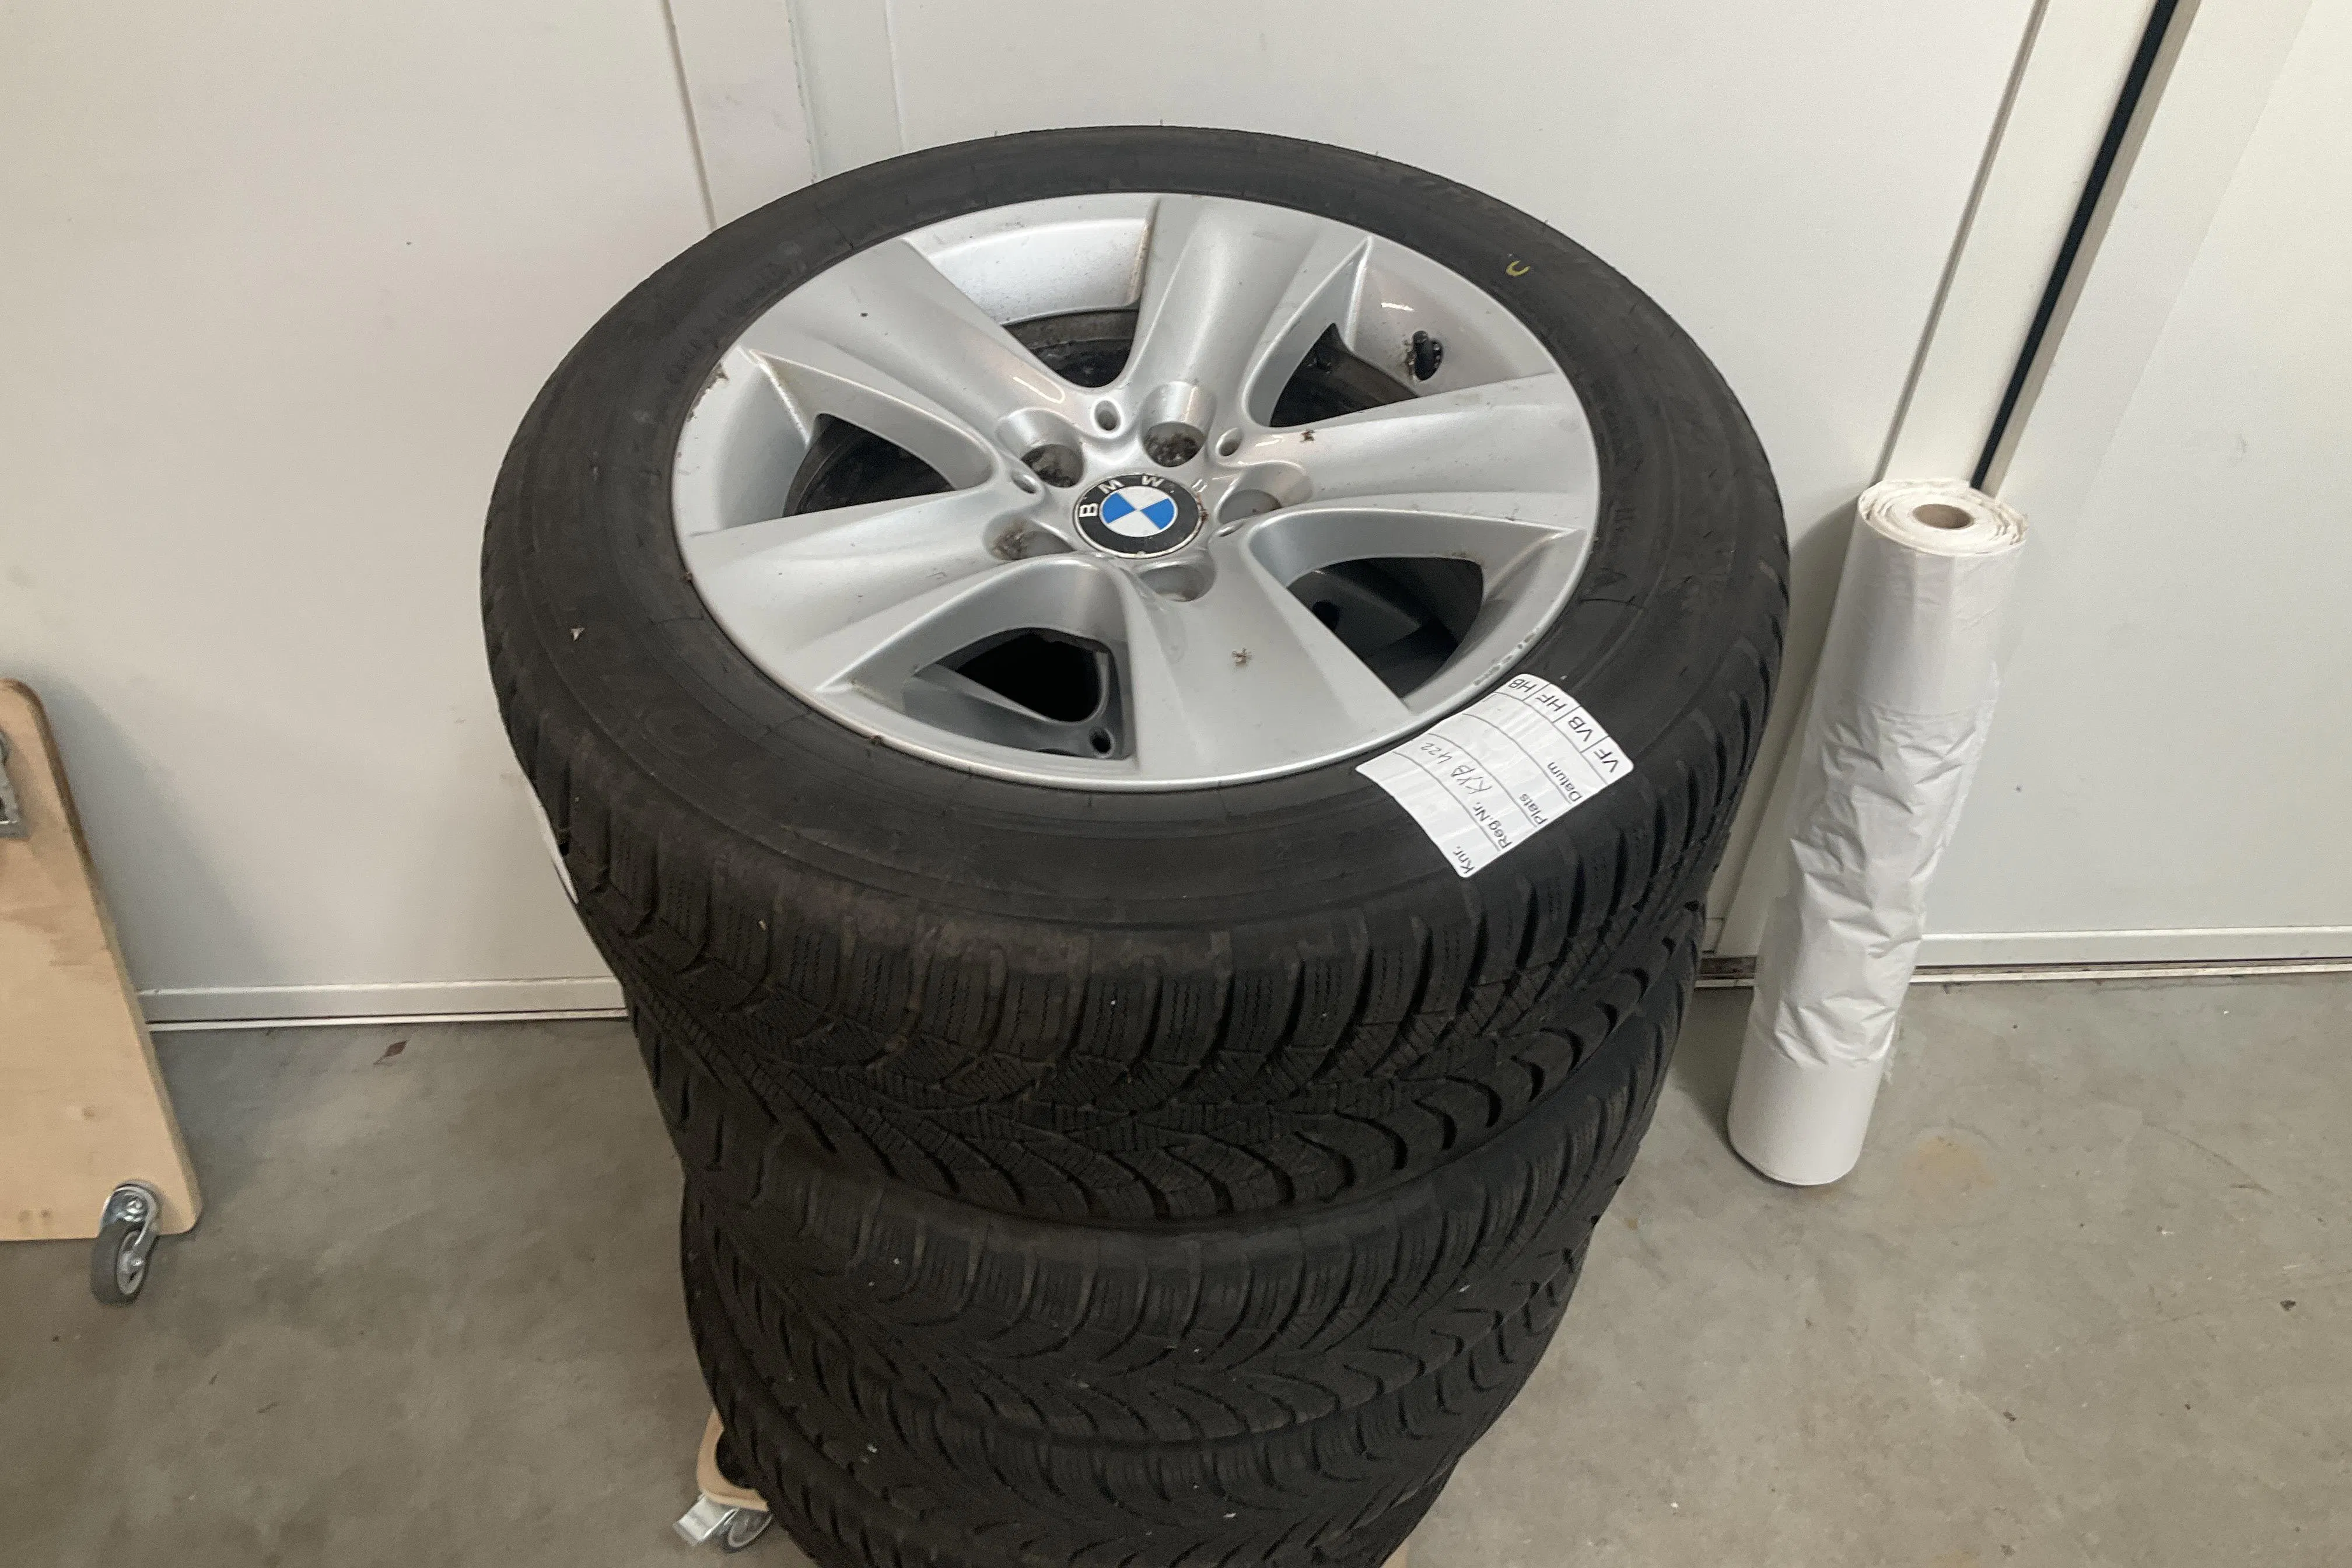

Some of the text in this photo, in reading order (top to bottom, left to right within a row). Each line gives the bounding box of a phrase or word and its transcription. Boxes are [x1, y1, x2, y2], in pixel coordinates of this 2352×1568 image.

[1079, 475, 1164, 517] BMW
[1508, 678, 1620, 773] VF VB HF HB
[1546, 761, 1582, 803] Datum
[1473, 802, 1512, 849] Reg.Nr.
[1519, 793, 1547, 825] Plats
[1453, 845, 1475, 873] Knr.
